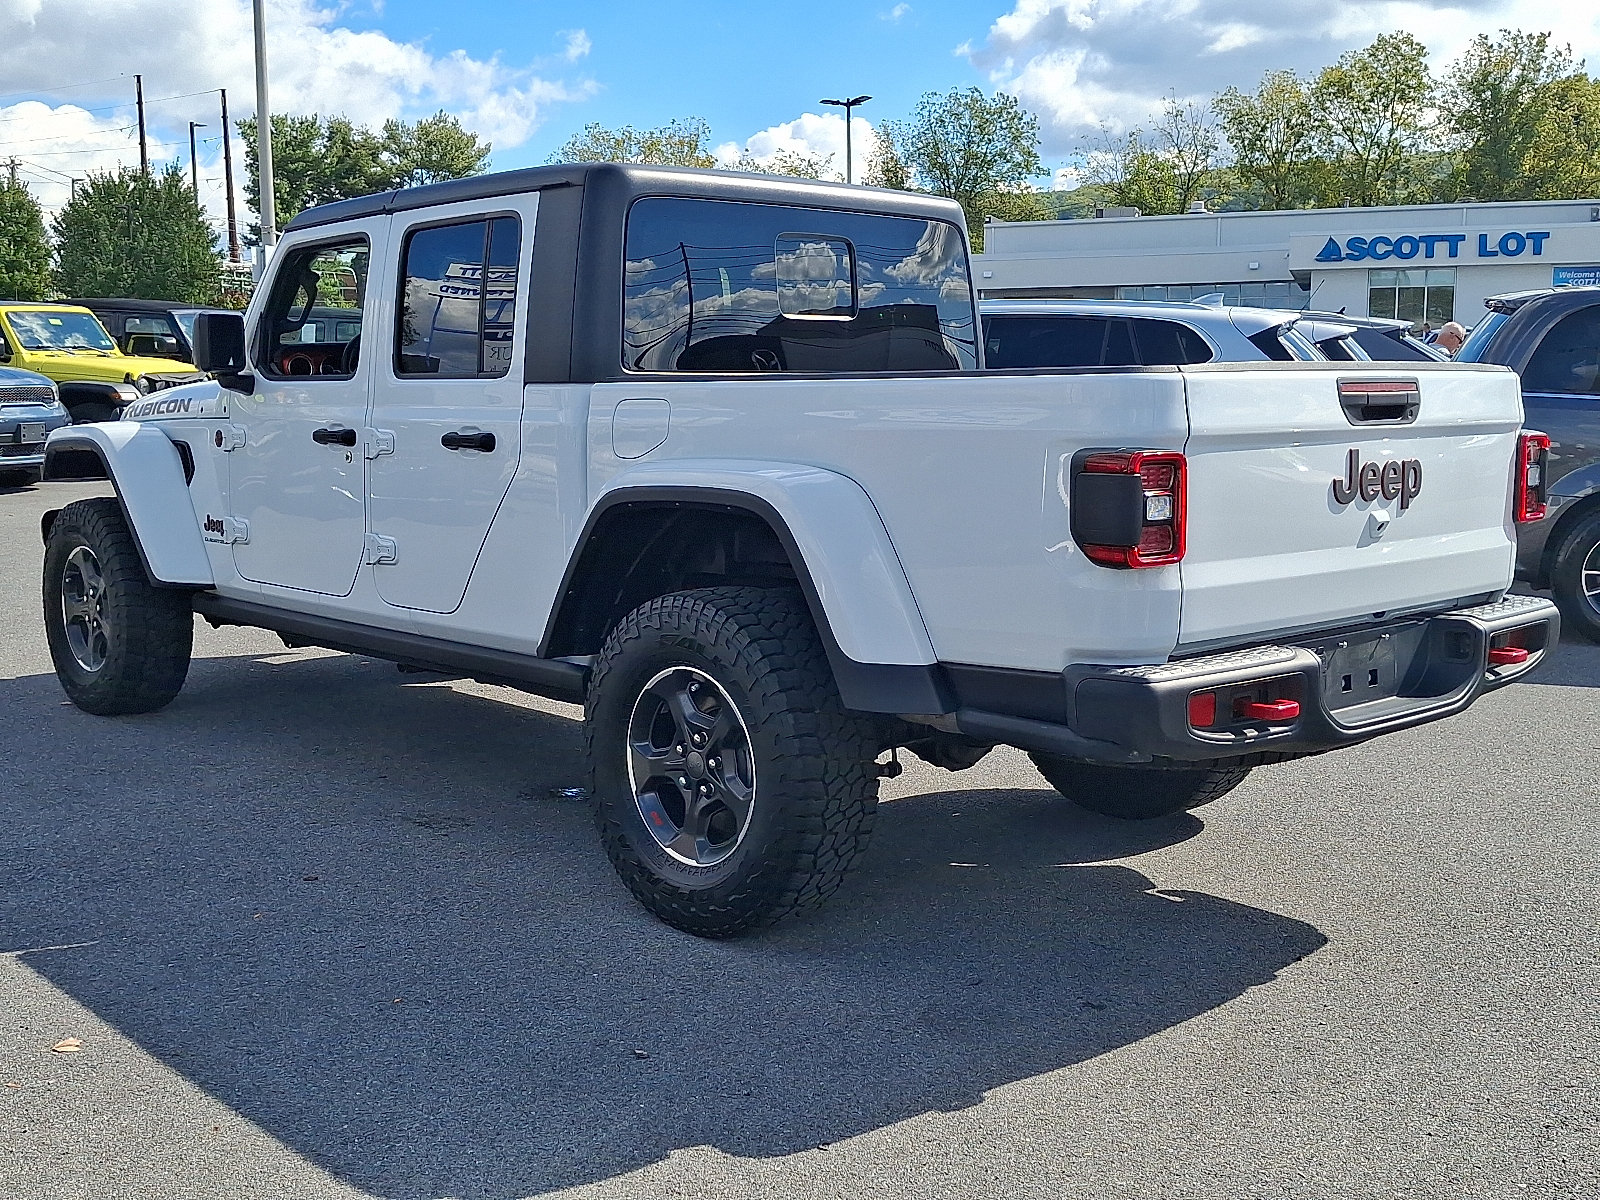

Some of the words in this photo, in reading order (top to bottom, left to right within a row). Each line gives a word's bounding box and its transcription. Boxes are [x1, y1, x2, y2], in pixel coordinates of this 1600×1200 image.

[1345, 234, 1466, 261] SCOTT
[1478, 231, 1550, 257] LOT
[1559, 271, 1595, 279] Welcome
[1569, 278, 1595, 287] SCOTT
[124, 398, 192, 419] RUBICON
[1332, 448, 1422, 510] Jeep
[204, 513, 224, 537] Jeep
